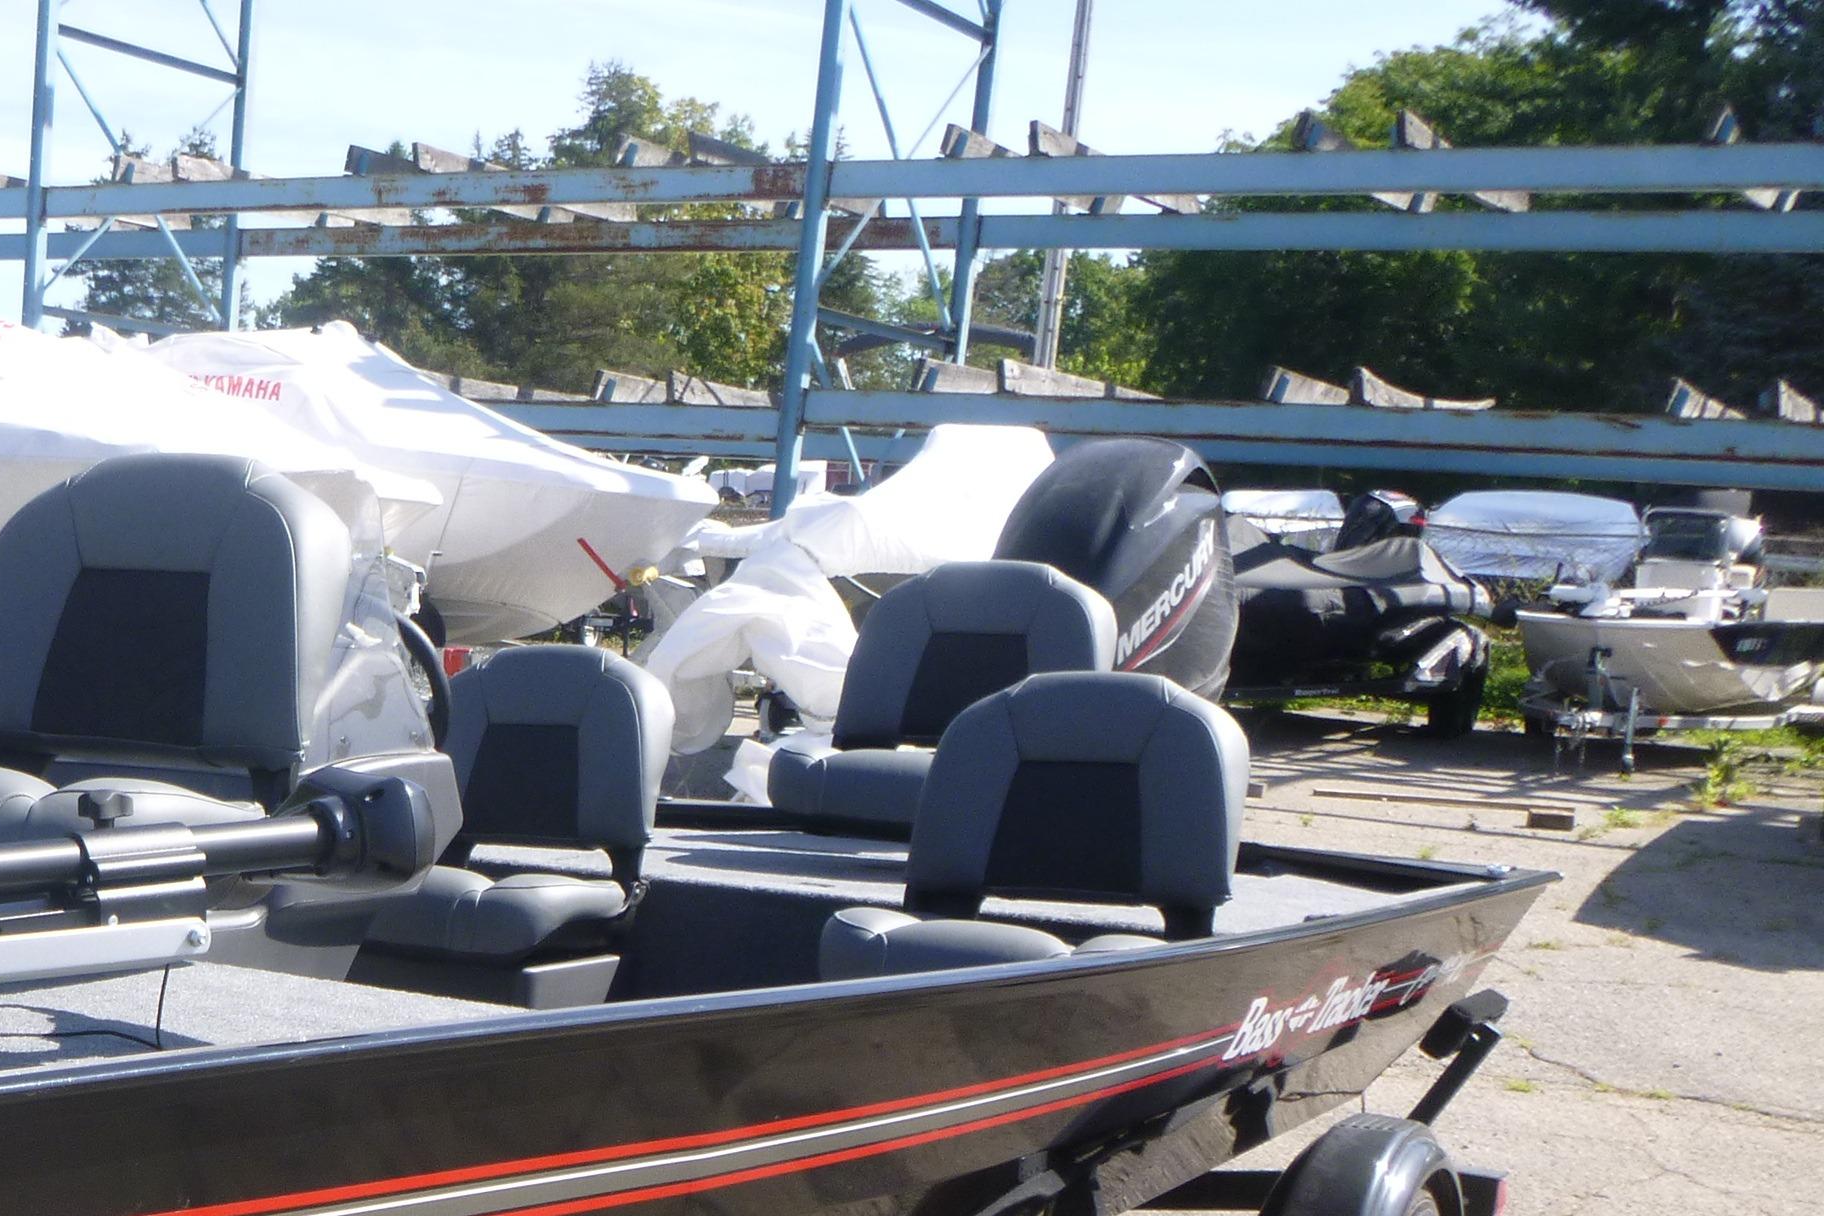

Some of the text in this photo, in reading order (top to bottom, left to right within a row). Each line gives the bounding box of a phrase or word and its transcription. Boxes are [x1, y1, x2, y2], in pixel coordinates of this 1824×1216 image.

[203, 375, 281, 401] YAMAHA
[1117, 518, 1215, 665] MERCURY
[1222, 997, 1295, 1060] Bass
[1307, 972, 1390, 1033] Tracker
